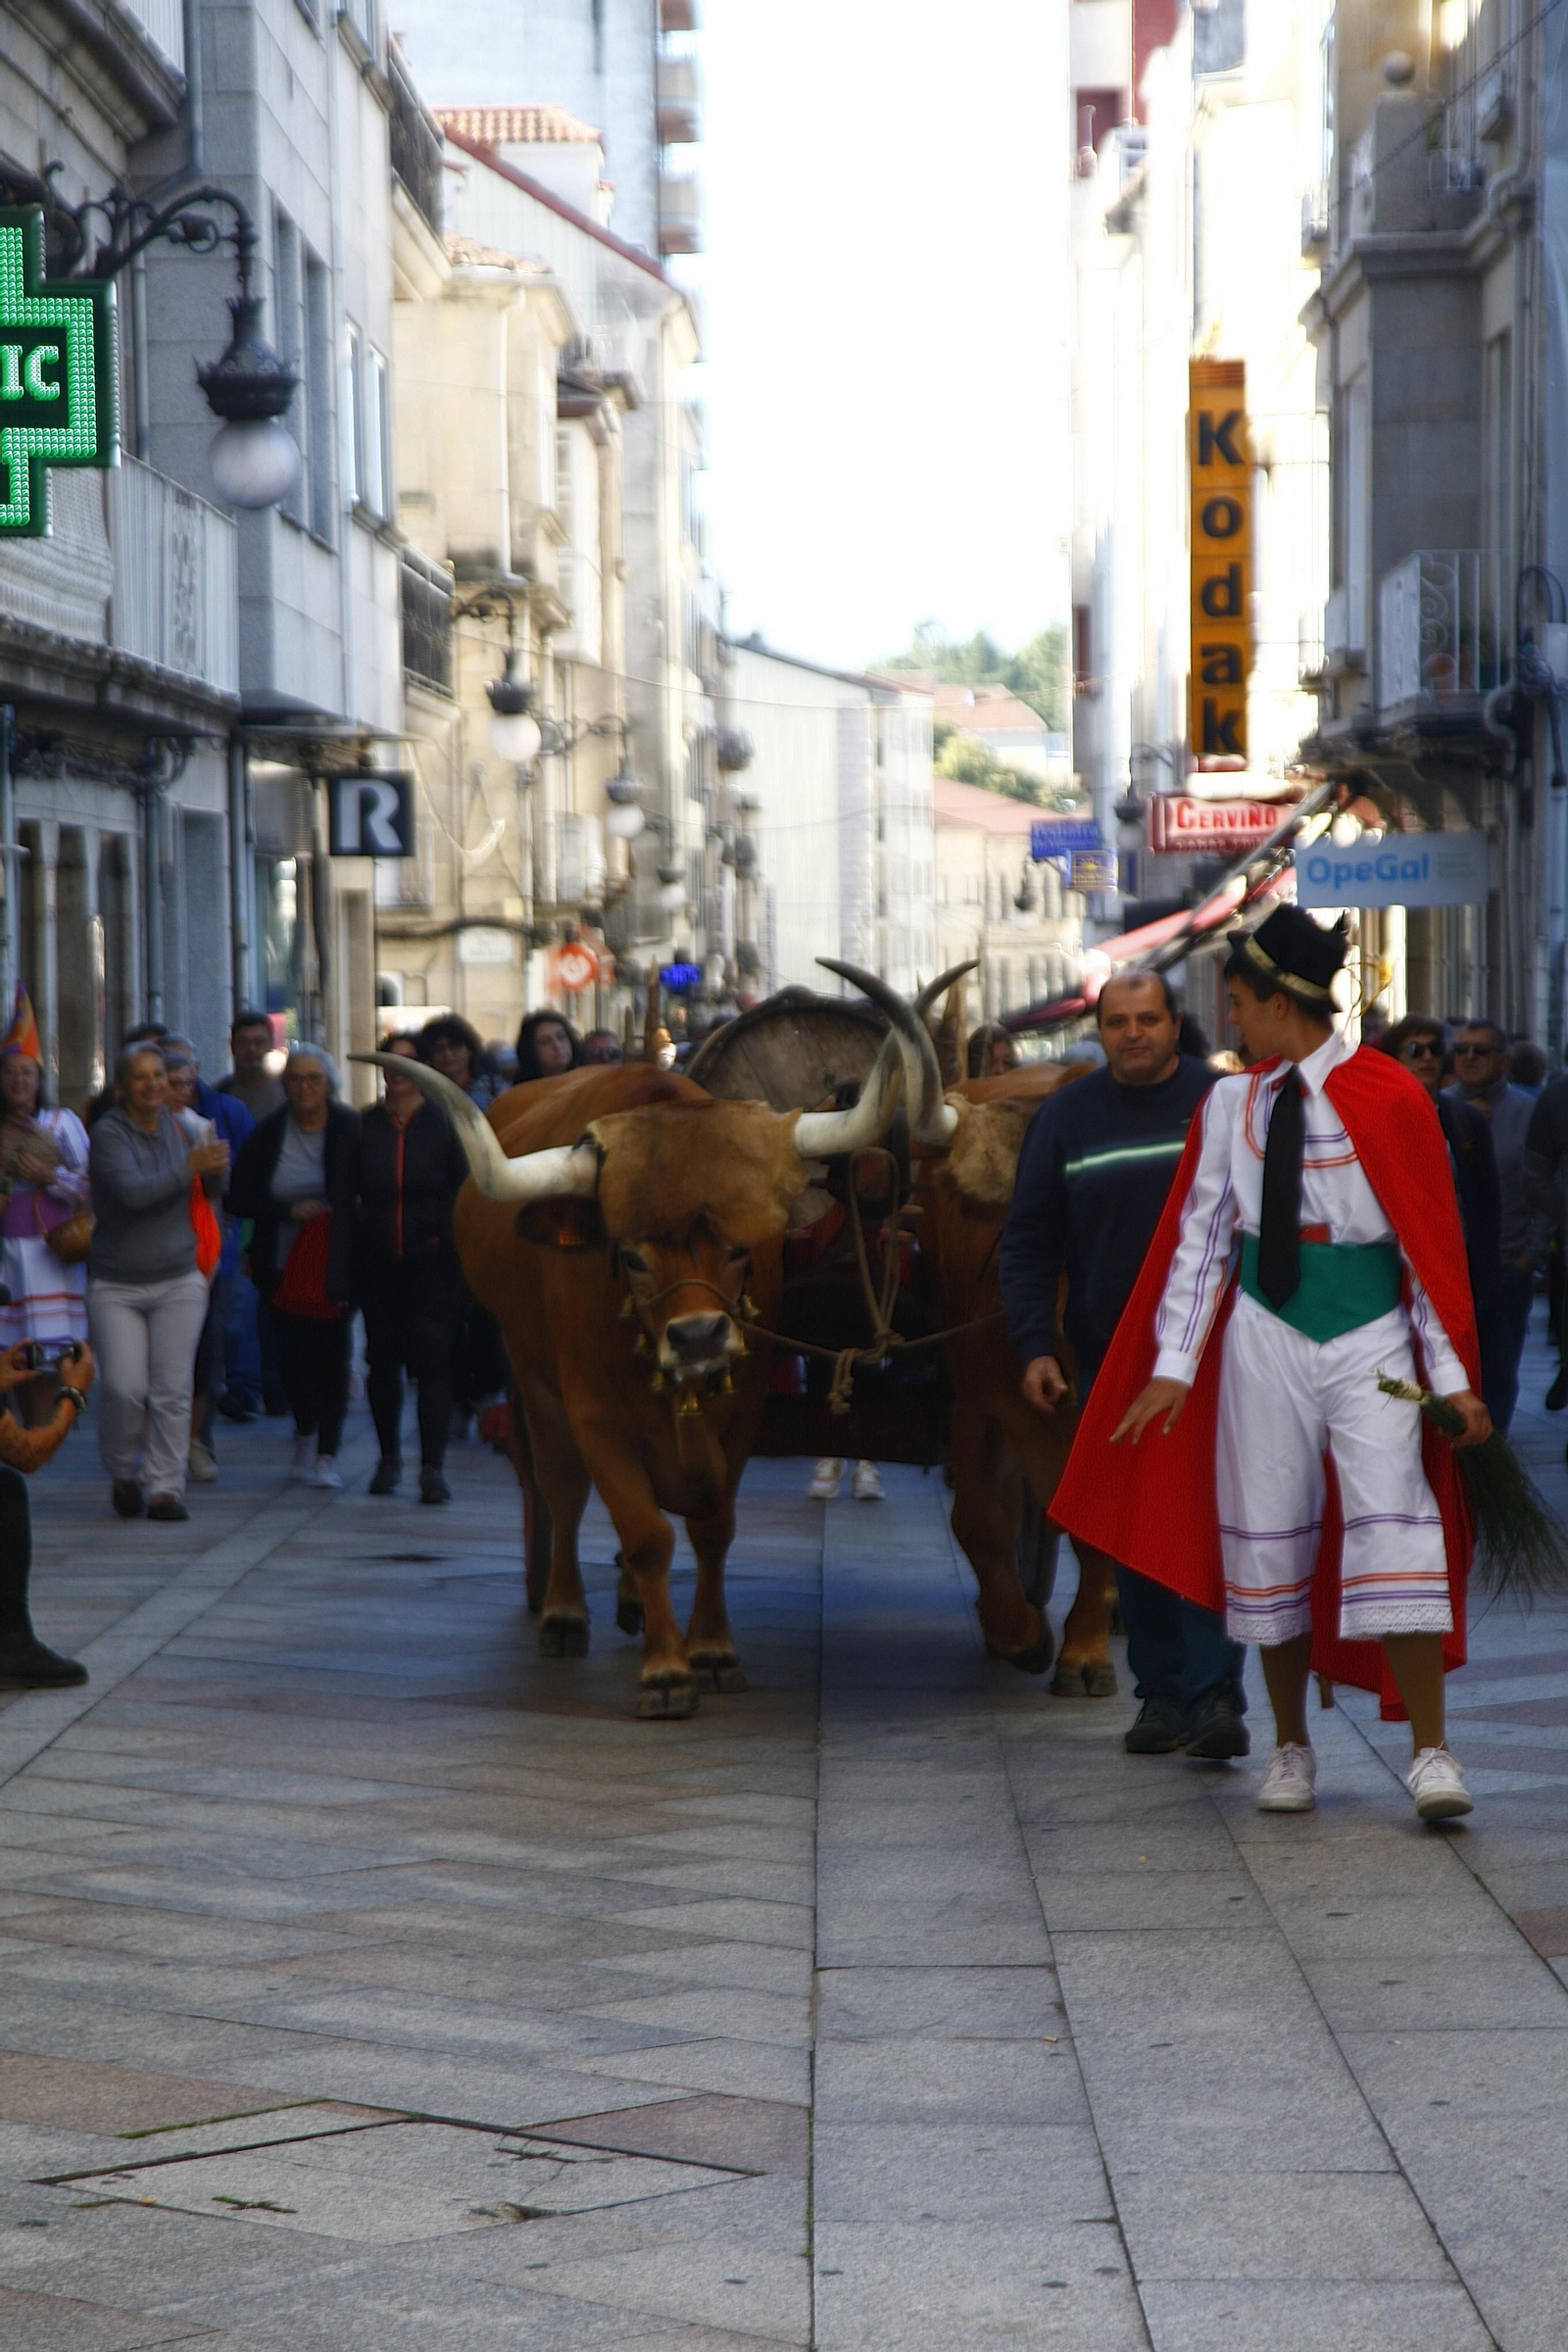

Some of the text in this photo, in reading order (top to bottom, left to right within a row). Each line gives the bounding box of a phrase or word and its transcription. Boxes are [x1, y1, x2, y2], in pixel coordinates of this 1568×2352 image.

[1198, 409, 1245, 753] Kodak
[339, 778, 403, 850] R
[1307, 854, 1430, 890] OpeGal
